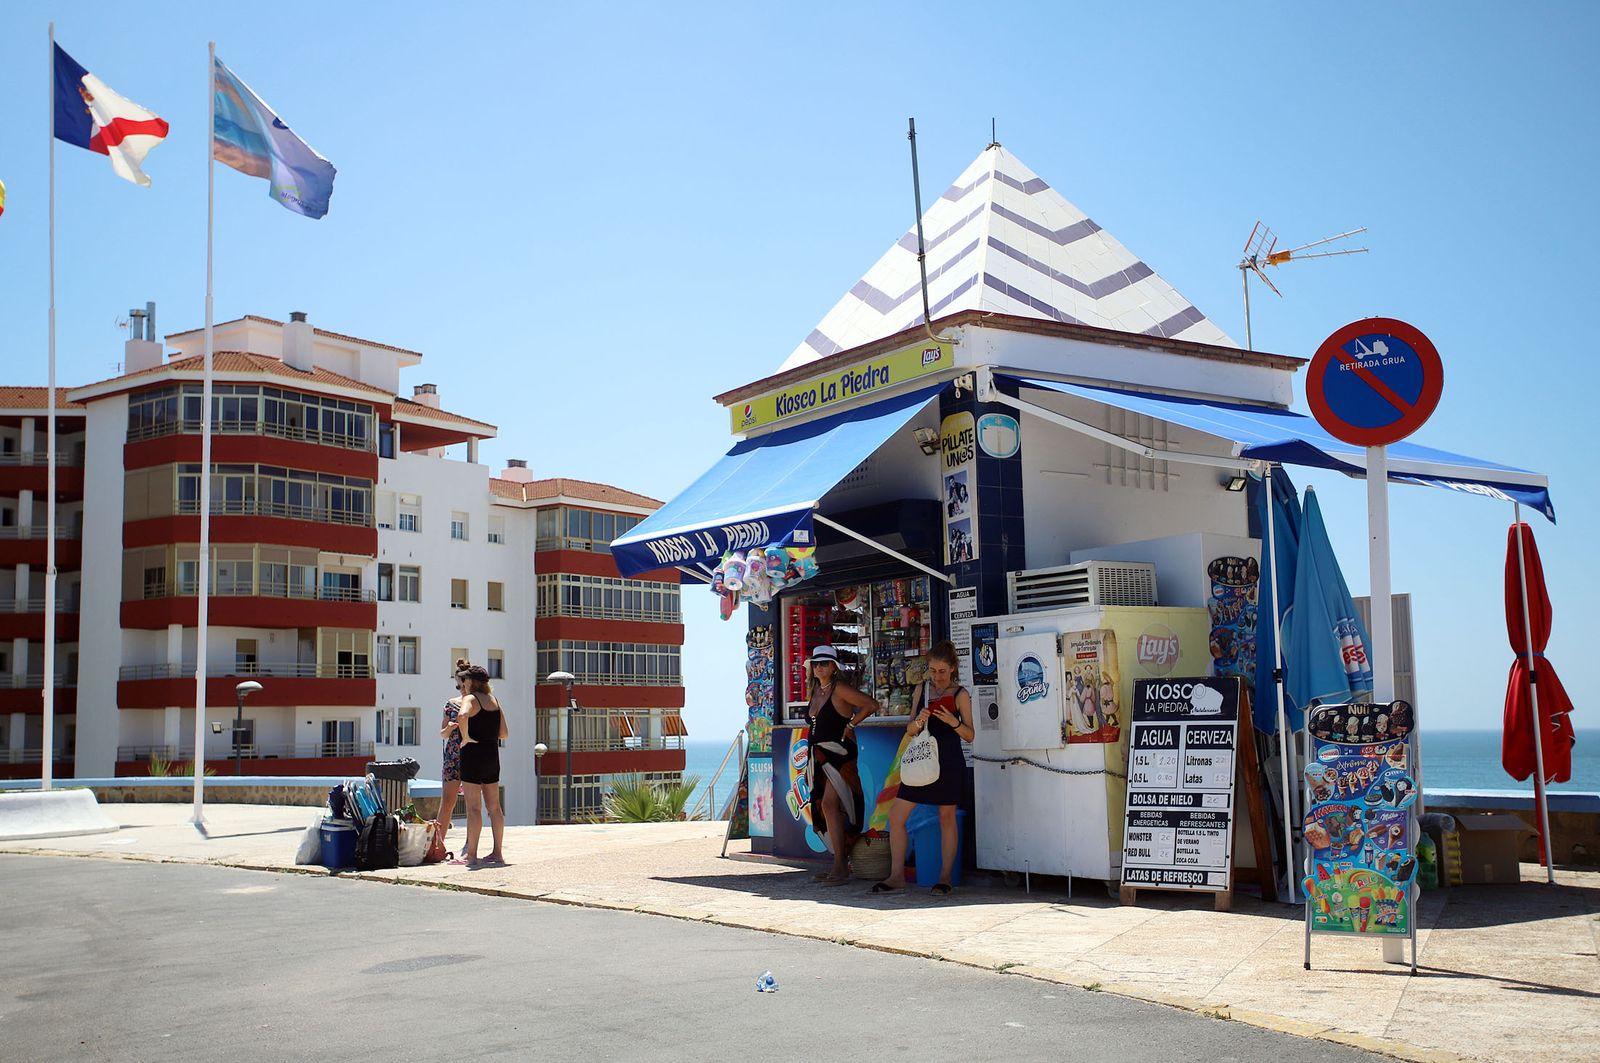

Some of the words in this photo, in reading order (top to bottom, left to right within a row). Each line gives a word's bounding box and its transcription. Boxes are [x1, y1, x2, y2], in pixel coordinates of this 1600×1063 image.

[1339, 360, 1380, 371] RETIRADA
[1382, 356, 1406, 365] GRUA
[775, 389, 816, 417] Kiosco
[820, 381, 836, 403] La
[840, 364, 889, 397] Piedra
[741, 416, 757, 428] pepsi
[946, 445, 974, 468] UN@S
[646, 535, 696, 564] KIOSCO
[695, 531, 719, 557] LA
[721, 521, 770, 551] PIEDRA
[953, 611, 974, 619] CERVEZA
[1140, 634, 1177, 665] Lay's
[1144, 702, 1156, 713] LA
[1157, 702, 1189, 713] PIEDRA
[1347, 704, 1370, 715] Nuii
[1140, 729, 1173, 746] AGUA
[1186, 730, 1233, 745] CERVEZA
[1135, 756, 1144, 766] 1.5
[1144, 756, 1150, 766] L.
[1186, 755, 1212, 766] Litronas
[1133, 773, 1143, 783] 0.5
[1143, 773, 1149, 783] L.
[1185, 774, 1203, 784] Latas
[1132, 794, 1157, 805] BOLSA
[1158, 794, 1169, 805] DE
[1170, 794, 1194, 806] HIELO
[1140, 811, 1163, 819] BEBIDAS
[1189, 812, 1216, 820] BEBIDAS
[1179, 820, 1226, 829] REFRESCANTES
[1128, 832, 1153, 841] MONSTER
[1127, 848, 1138, 857] RED
[1138, 848, 1151, 857] BULL
[1126, 869, 1150, 880] LATAS
[1151, 870, 1162, 881] DE
[1163, 871, 1204, 883] REFRESCO
